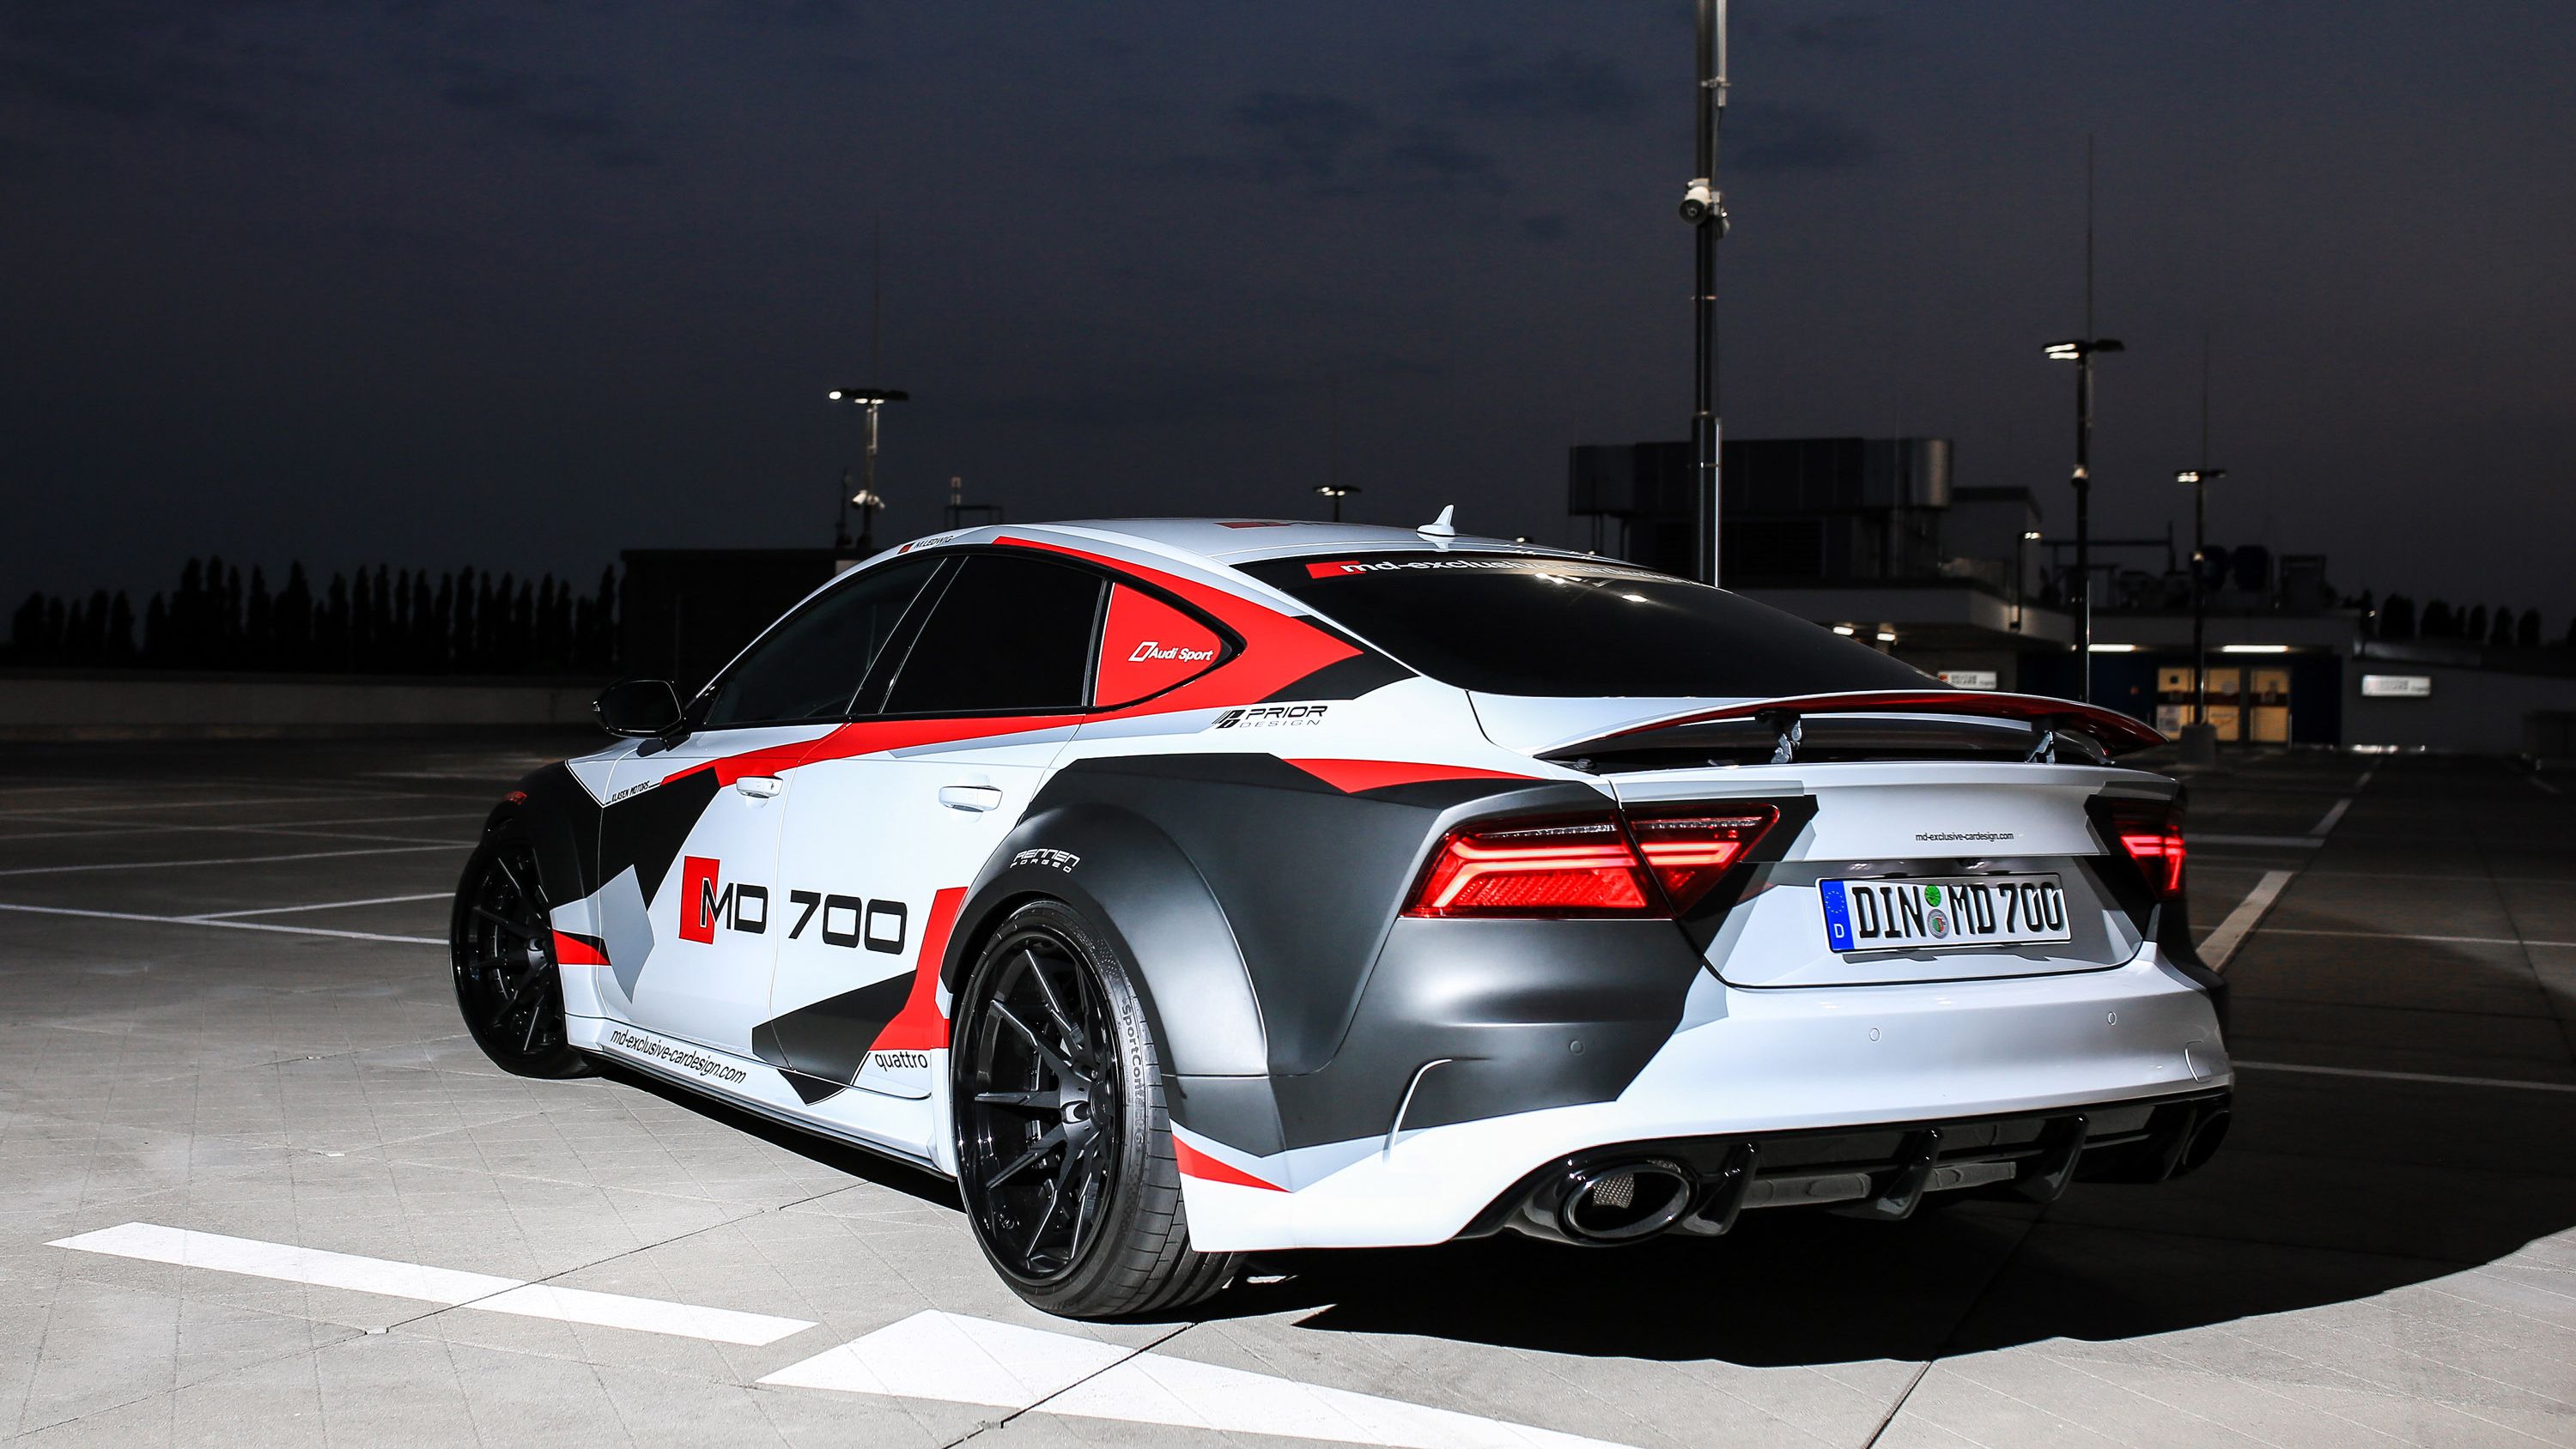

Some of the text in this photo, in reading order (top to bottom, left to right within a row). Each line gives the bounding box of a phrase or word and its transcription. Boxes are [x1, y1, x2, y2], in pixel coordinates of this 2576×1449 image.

[1148, 647, 1213, 663] Audi Sport
[1246, 706, 1328, 719] PRIOR
[1239, 719, 1321, 729] DESIGN
[1915, 831, 2014, 842] md-exclusive-cardesign.com
[1009, 858, 1072, 874] FORGED
[700, 878, 908, 955] MD 700
[1851, 885, 1926, 938] DIN
[1997, 881, 2063, 934] 700
[1834, 923, 1845, 938] D
[610, 1029, 747, 1084] md-exclusive-cardesign.com
[874, 1051, 928, 1072] quattro
